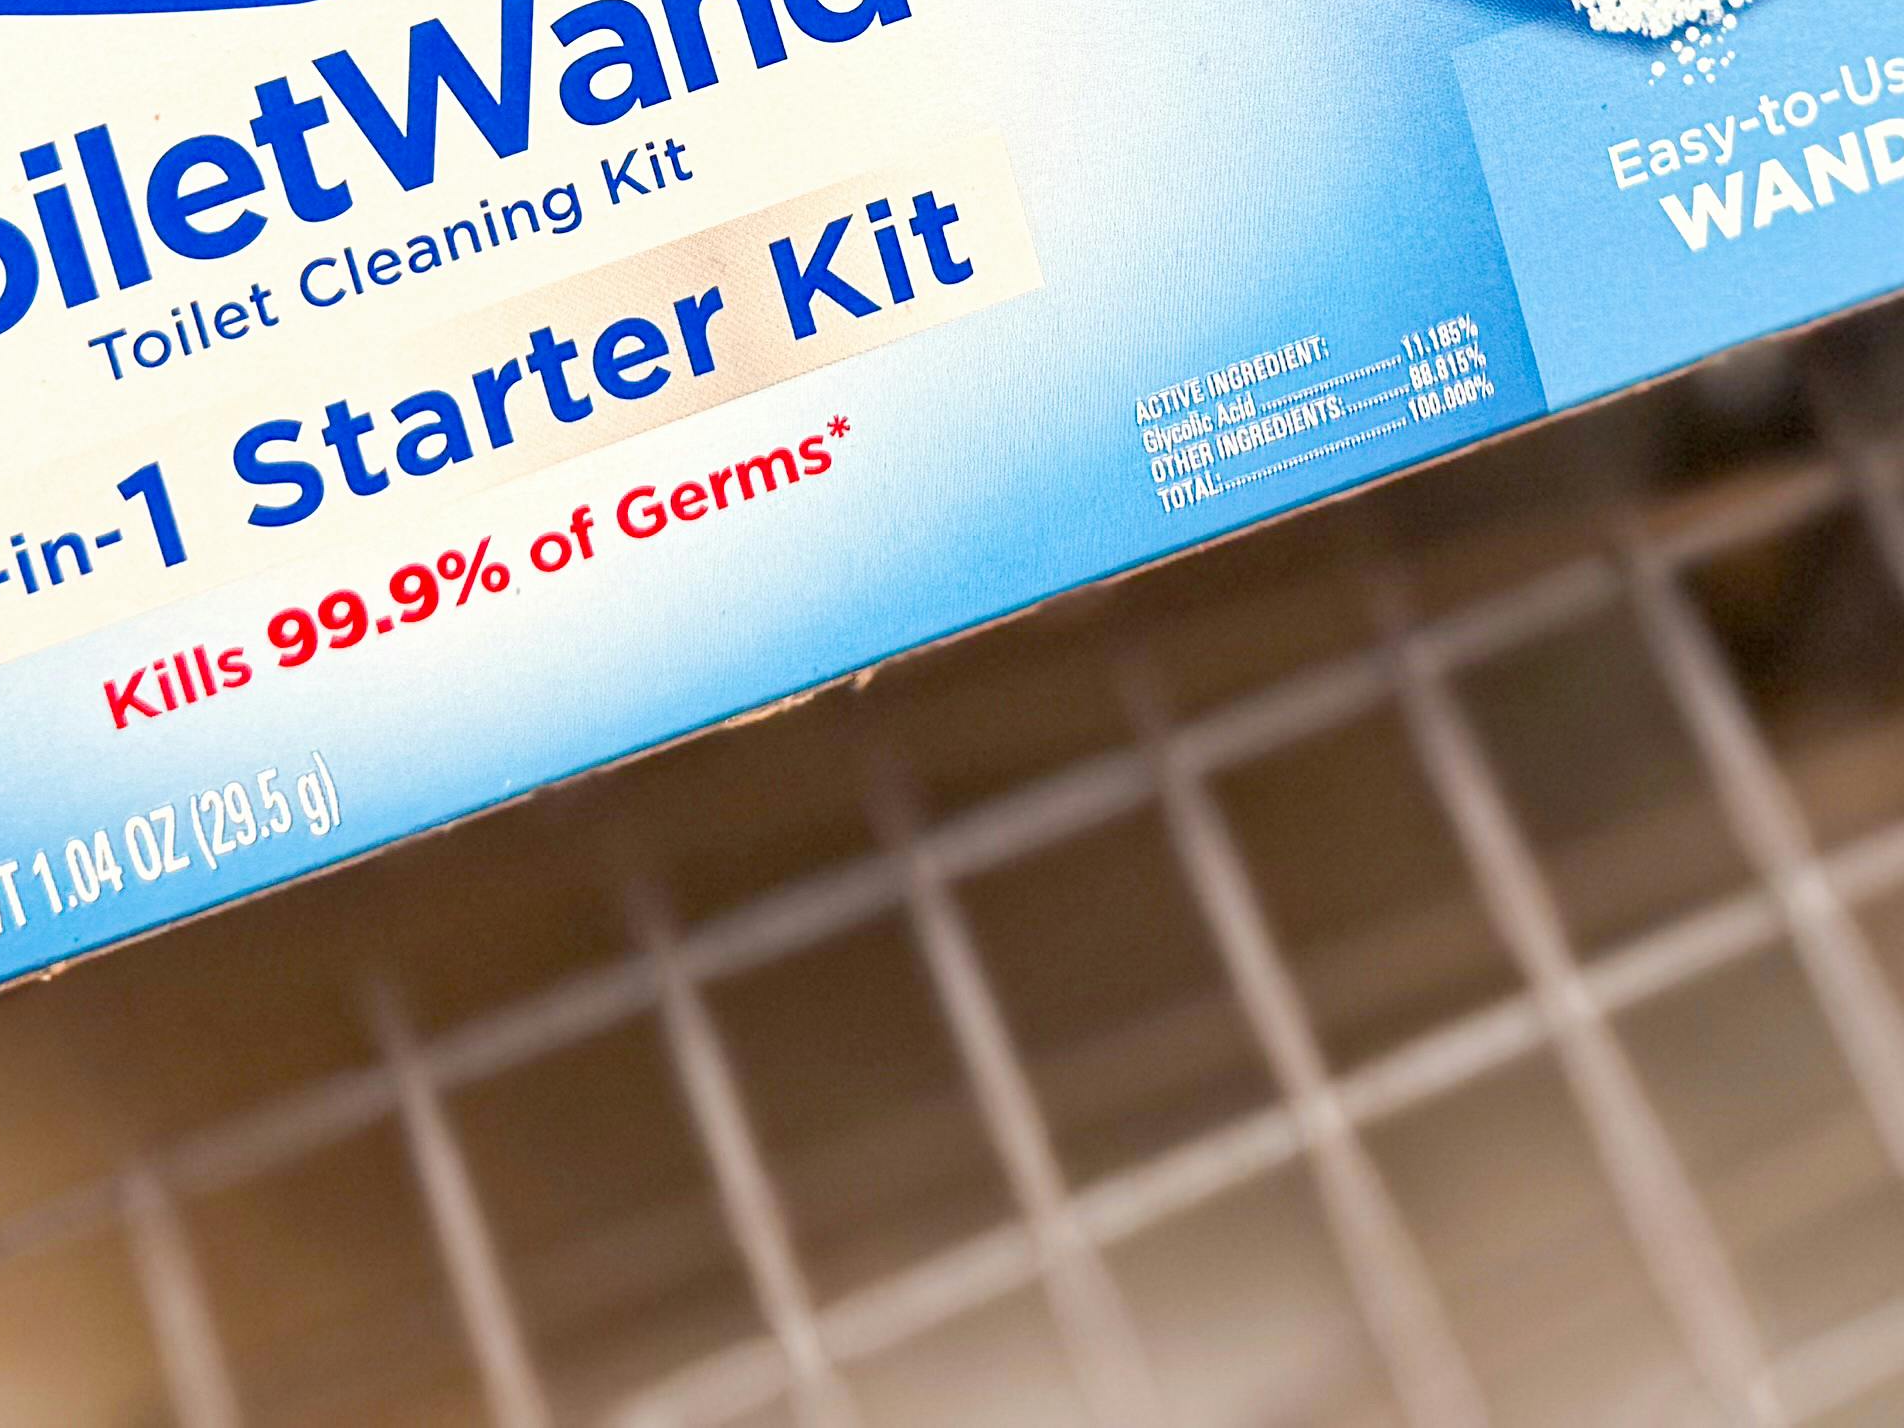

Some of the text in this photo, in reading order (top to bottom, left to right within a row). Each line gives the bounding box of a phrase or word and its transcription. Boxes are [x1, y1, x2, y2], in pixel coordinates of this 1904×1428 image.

[87, 138, 694, 381] Toilet Cleaning Kit
[232, 286, 724, 528] Starter
[768, 190, 975, 341] Kit
[1132, 334, 1330, 425] ACTIVE INGREDIENT:
[1141, 313, 1479, 460] Glycolic Acid 11.185%
[1150, 437, 1215, 484] OTHER
[1215, 393, 1346, 460] INGREDIENTS:
[1156, 372, 1495, 513] TOTAL: 100.000%
[103, 646, 253, 730] Kills
[267, 536, 511, 668] 99.9%
[529, 505, 595, 574] of
[32, 828, 124, 914] 1.04
[124, 799, 190, 882] OZ
[179, 760, 292, 869] (29.5
[283, 742, 340, 837] g)
